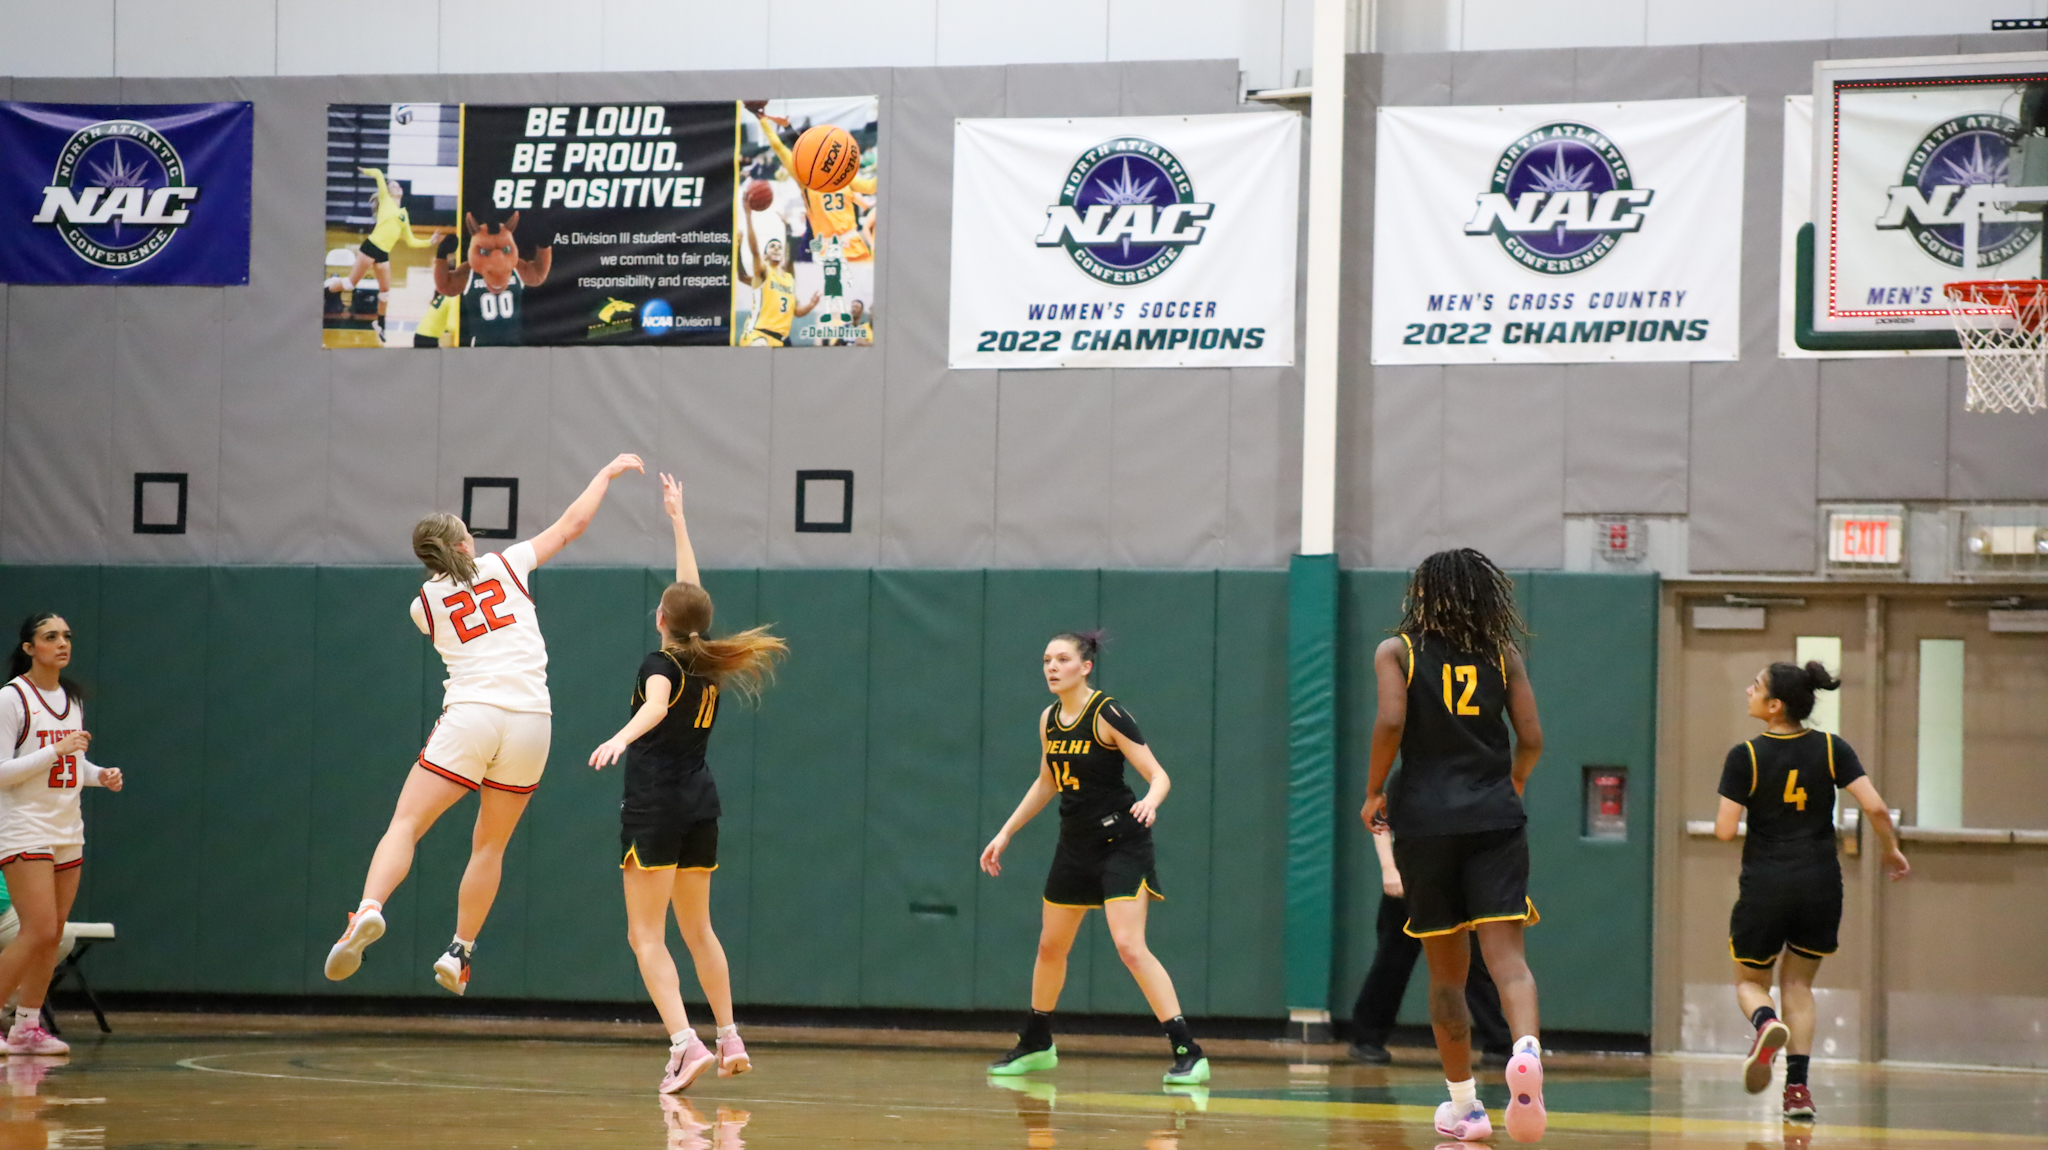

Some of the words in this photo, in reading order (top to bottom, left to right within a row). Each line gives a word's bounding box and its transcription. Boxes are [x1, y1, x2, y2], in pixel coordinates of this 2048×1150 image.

[525, 107, 570, 137] BE
[576, 106, 671, 137] LOUD.
[60, 125, 102, 178] NORTH
[108, 124, 180, 178] ATLANTIC
[511, 143, 556, 173] BE
[563, 142, 684, 172] PROUD.
[821, 140, 842, 174] NCAA
[1495, 131, 1546, 185] NORTH
[1550, 126, 1629, 181] ATLANTIC
[1907, 121, 1959, 177] NORTH
[1064, 144, 1110, 198] NORTH
[1115, 140, 1192, 195] ATLANTIC
[32, 186, 198, 224] NAC
[492, 178, 536, 209] BE
[543, 177, 705, 208] POSITIVE!
[823, 193, 845, 212] 23
[1035, 202, 1215, 247] NAC
[1464, 189, 1654, 236] NAC
[69, 229, 167, 263] CONFERENCE
[553, 232, 569, 245] As
[572, 232, 617, 244] Division
[632, 231, 731, 244] student-athletes,
[1505, 234, 1616, 272] CONFERENCE
[1919, 227, 2035, 266] CONFRENCE
[600, 254, 617, 265] we
[619, 253, 664, 265] commit
[667, 254, 679, 265] to
[681, 252, 702, 265] fair
[704, 252, 731, 267] play,
[1074, 247, 1179, 283] CONFERENCE
[578, 275, 656, 289] responsibility
[658, 275, 680, 286] and
[683, 275, 730, 288] respect.
[1867, 286, 1933, 306] MEN'S
[480, 290, 514, 321] 00
[780, 297, 788, 312] 3
[1028, 301, 1126, 321] WOMEN'S
[1139, 301, 1217, 319] SOCCER
[1428, 292, 1494, 312] MEN'S
[1508, 293, 1575, 310] CROSS
[1589, 290, 1687, 309] COUNTRY
[642, 316, 673, 327] NCAA
[675, 316, 712, 327] Division
[801, 326, 867, 338] #DelhiDrive
[1402, 322, 1492, 345] 2022
[1502, 319, 1709, 344] CHAMPIONS
[977, 329, 1063, 352] 2022
[1070, 327, 1266, 351] CHAMPIONS
[1843, 520, 1889, 556] EXIT
[442, 578, 517, 644] 22
[1442, 663, 1480, 716] 12
[48, 755, 77, 788] 23
[1052, 761, 1080, 792] 14
[1783, 769, 1807, 811] 4
